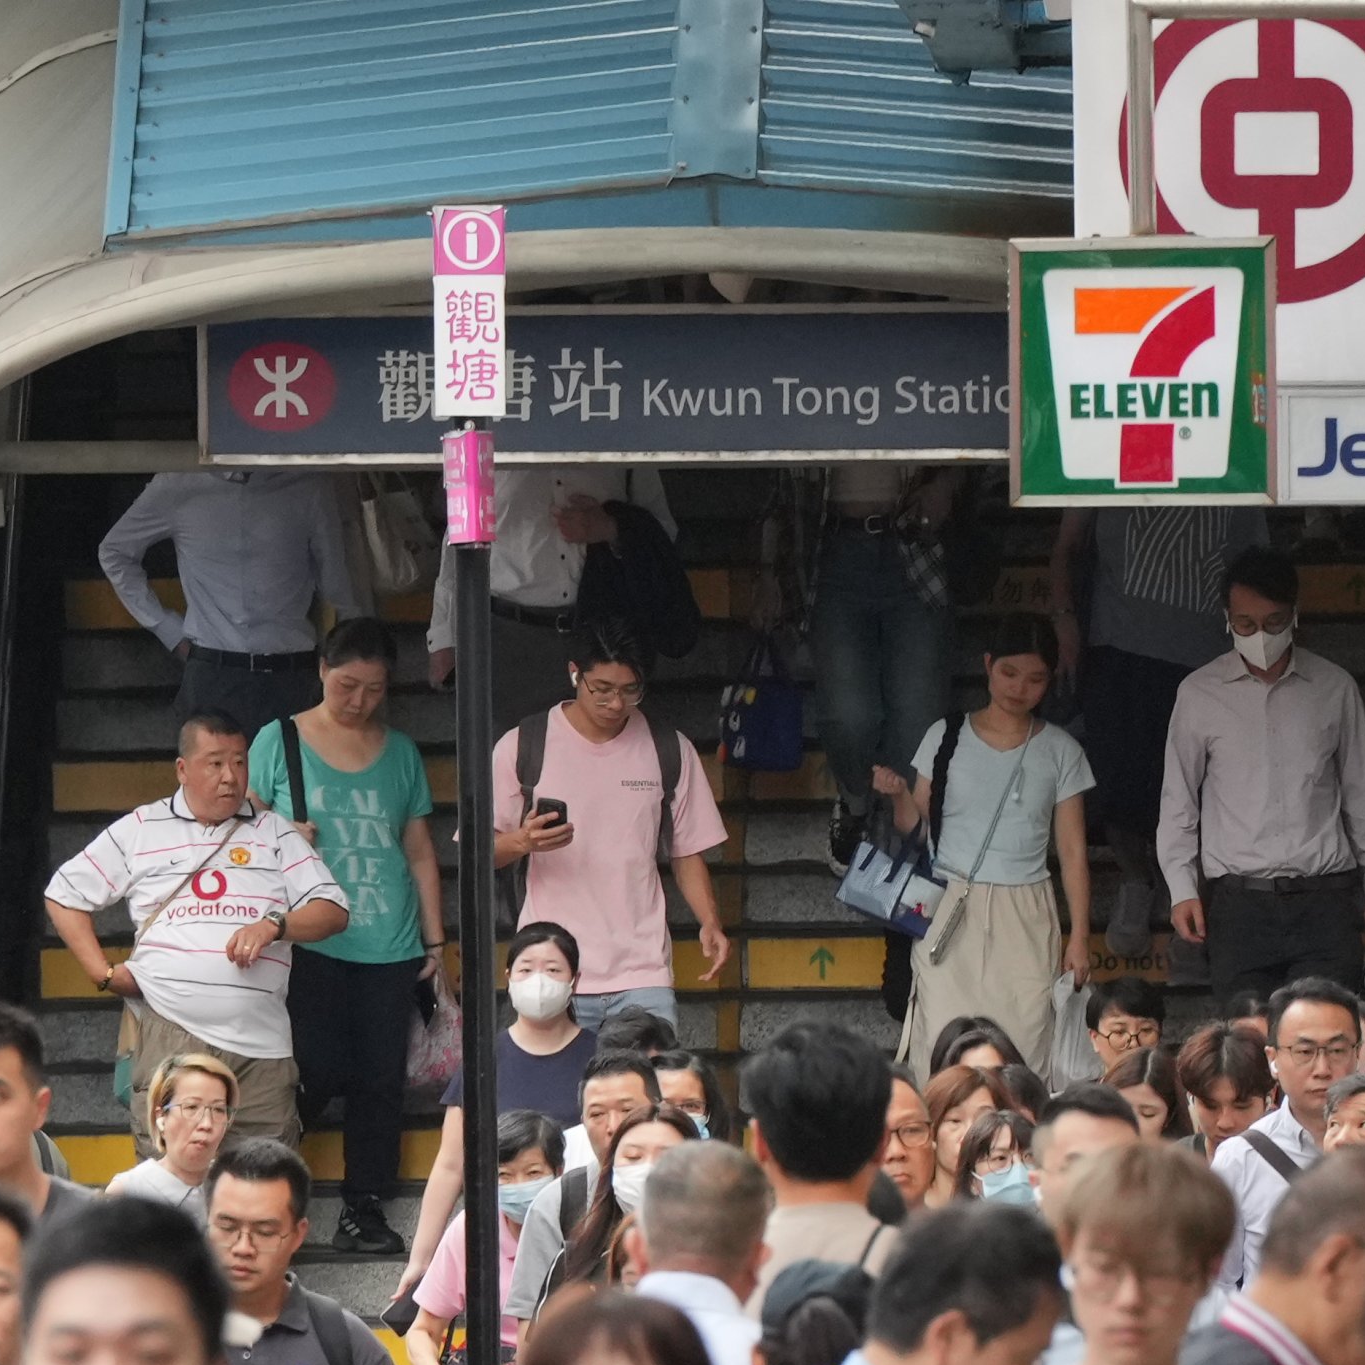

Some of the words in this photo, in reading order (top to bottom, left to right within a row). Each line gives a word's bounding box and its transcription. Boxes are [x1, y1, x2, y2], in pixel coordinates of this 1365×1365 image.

[445, 290, 500, 400] 觀塘
[1074, 285, 1216, 483] 7
[642, 377, 762, 416] Kwun
[772, 376, 879, 426] Tong
[166, 900, 260, 921] vodafone
